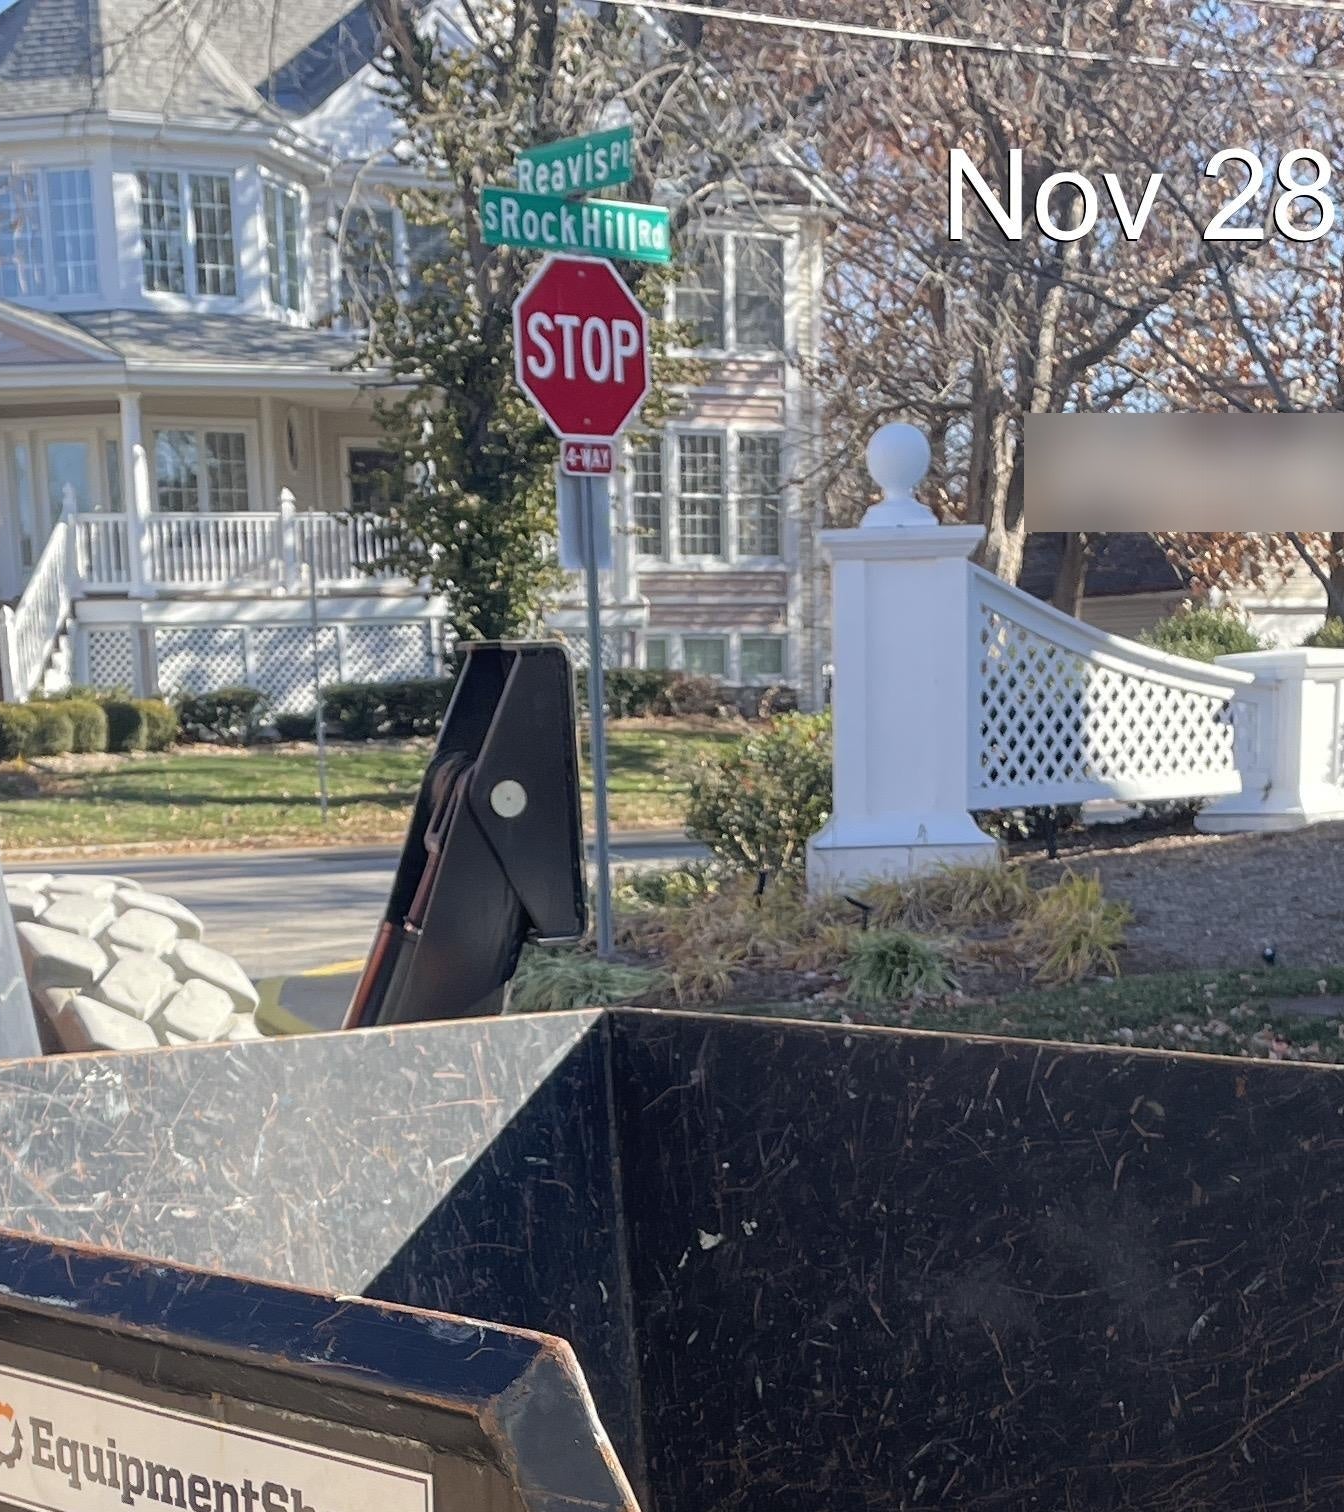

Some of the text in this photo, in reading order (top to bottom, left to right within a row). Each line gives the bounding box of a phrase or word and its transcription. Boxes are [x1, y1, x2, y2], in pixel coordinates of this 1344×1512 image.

[518, 142, 610, 195] Reavis
[501, 196, 578, 246] Rock
[582, 206, 638, 252] Hill
[638, 219, 665, 249] Rd
[527, 311, 640, 384] STOP
[565, 445, 611, 470] 4-WAY
